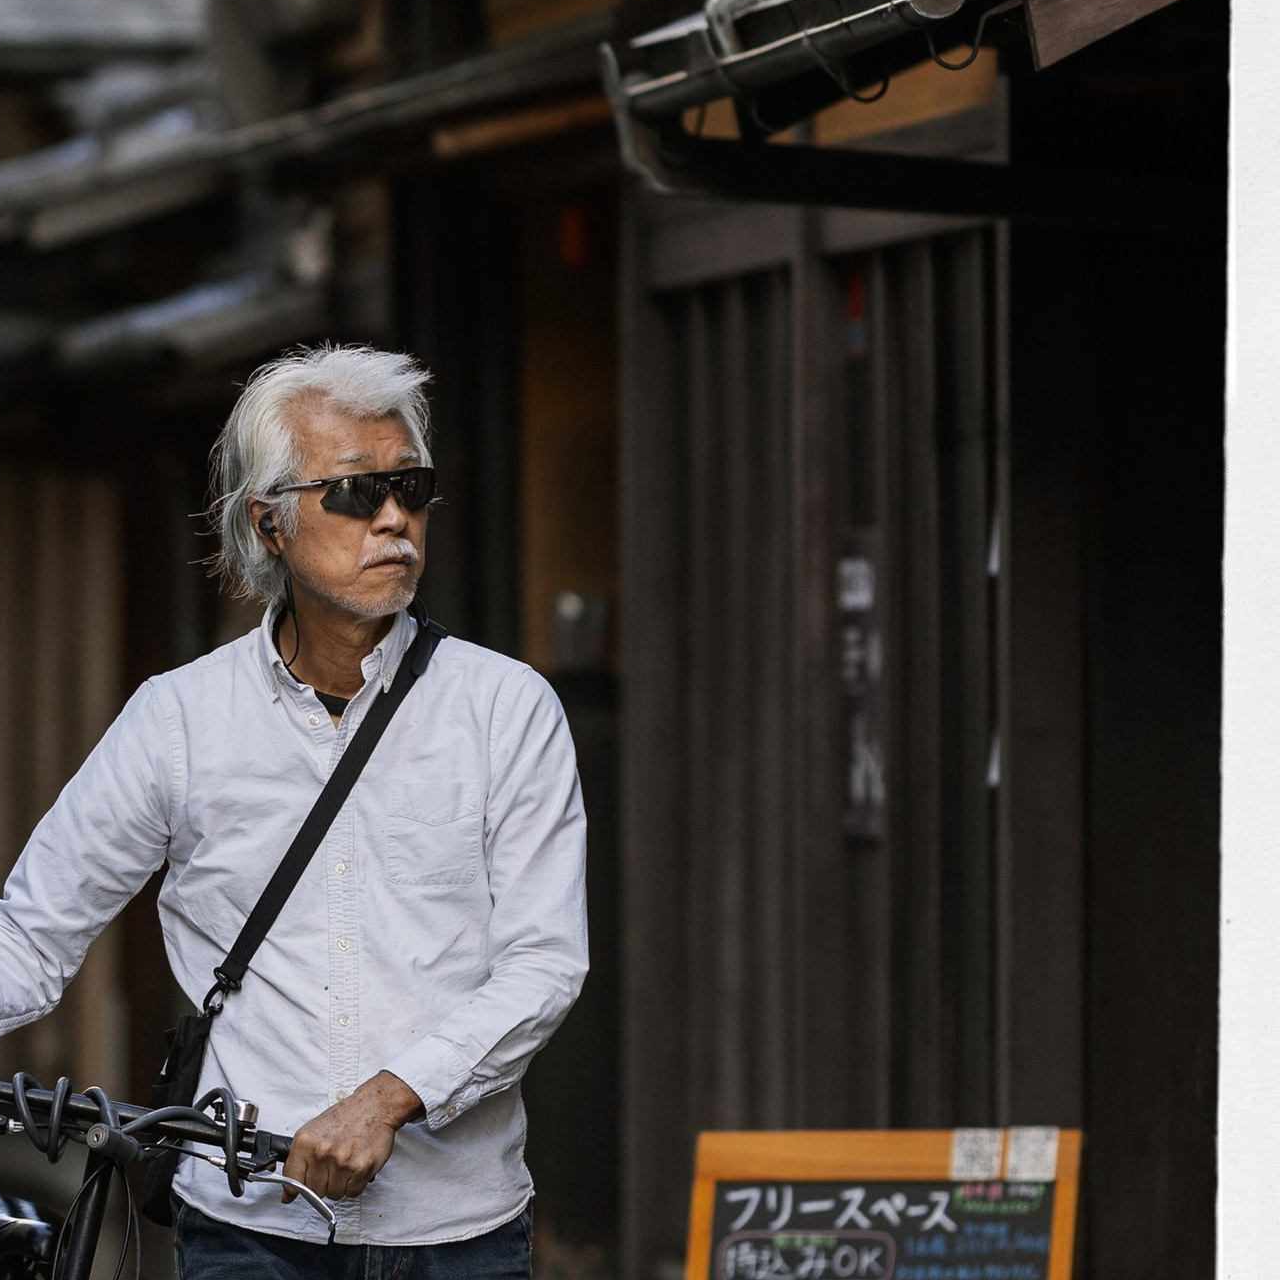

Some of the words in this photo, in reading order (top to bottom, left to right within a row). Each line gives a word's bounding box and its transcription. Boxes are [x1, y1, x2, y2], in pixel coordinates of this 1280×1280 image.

[725, 1185, 957, 1232] フリースペース
